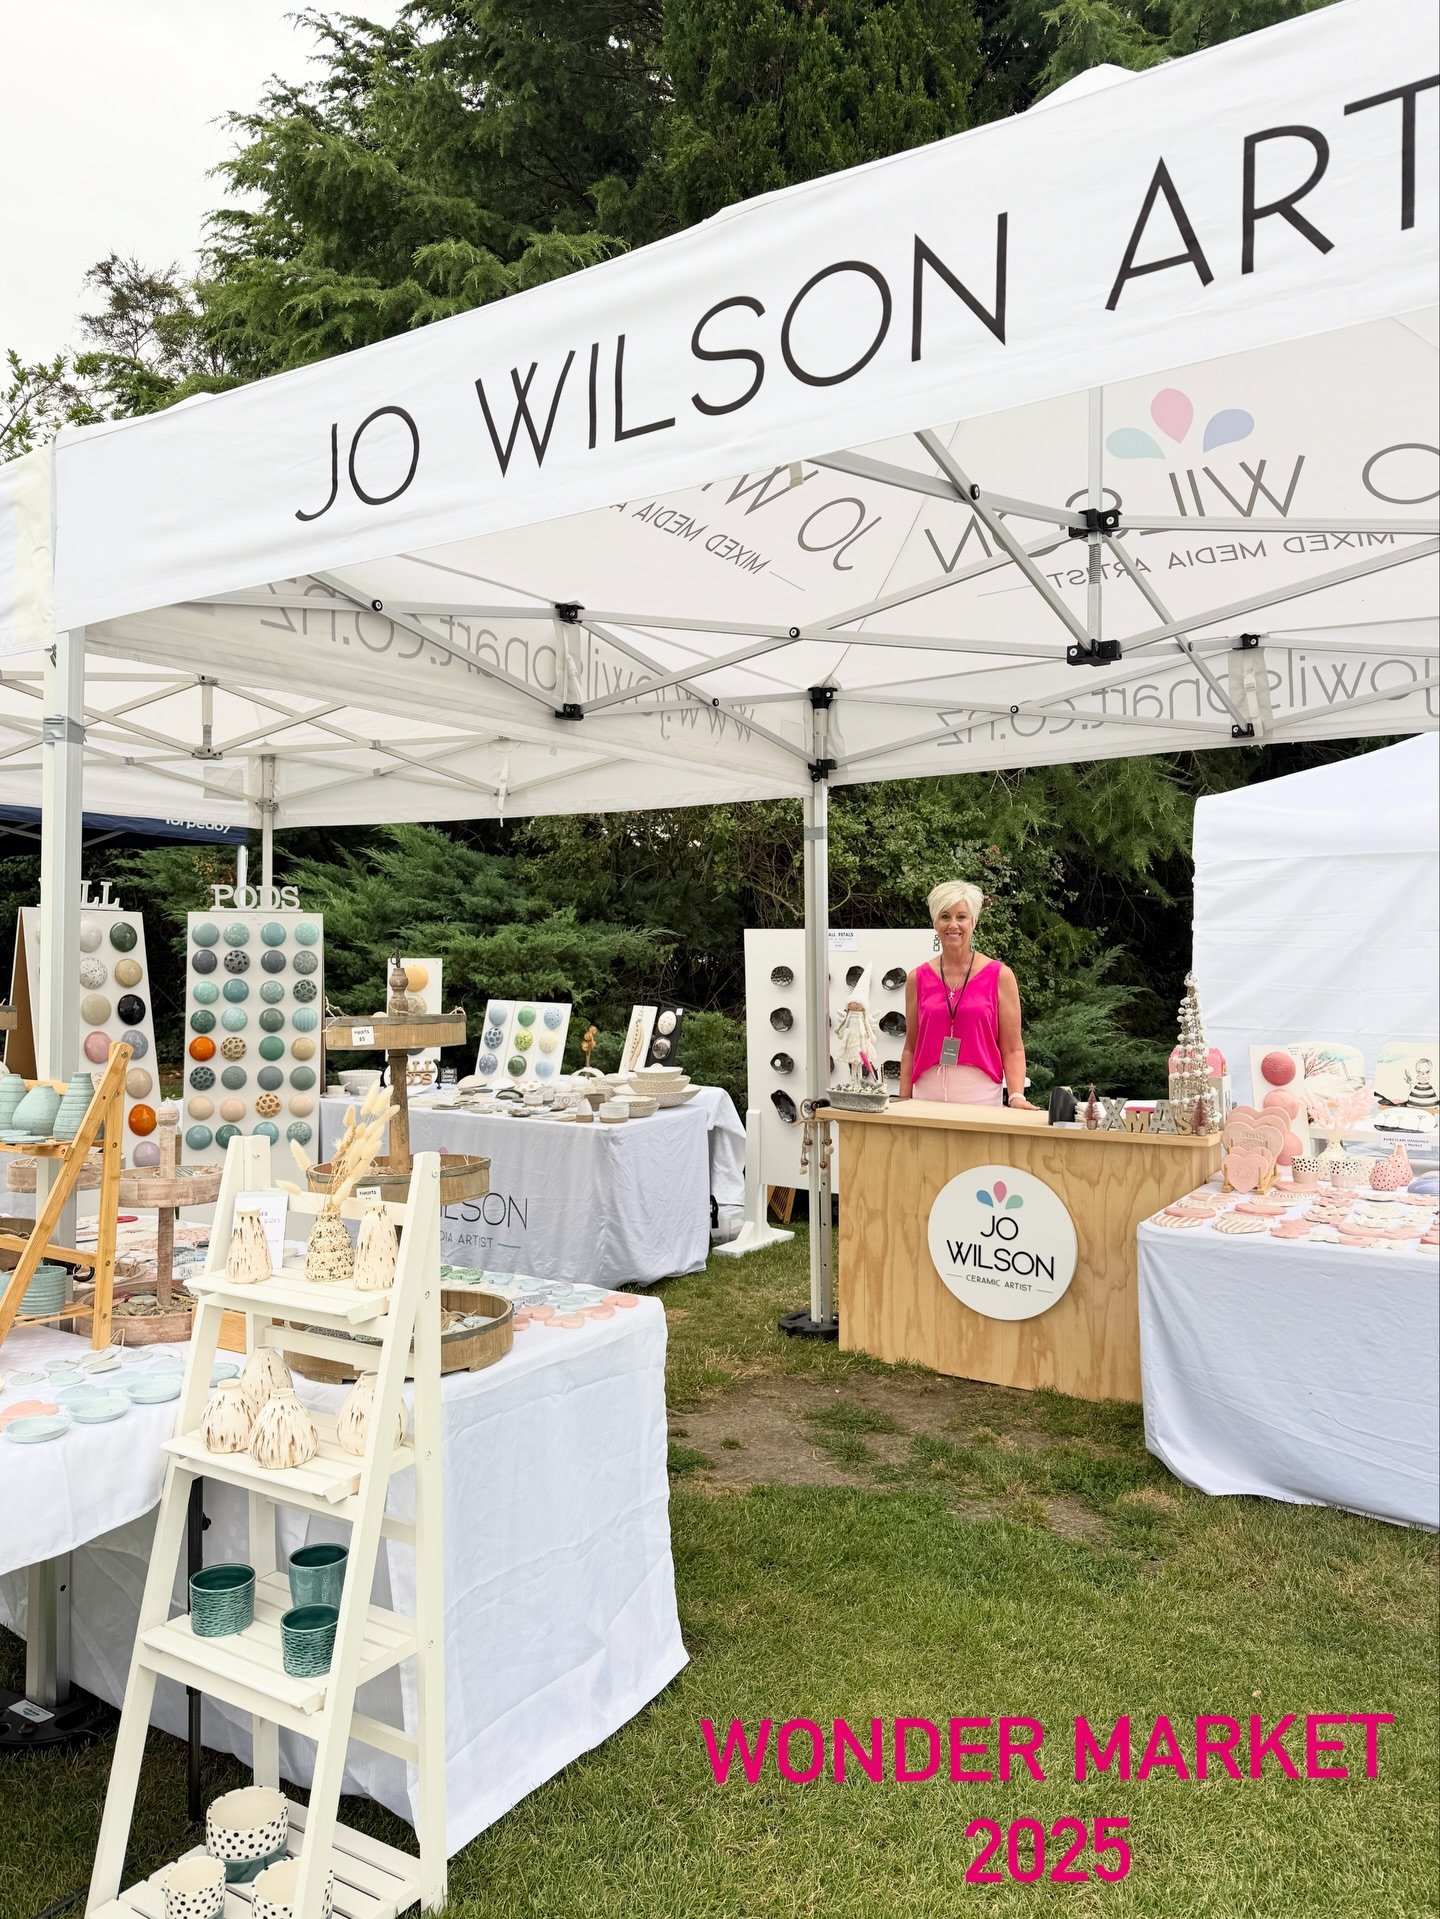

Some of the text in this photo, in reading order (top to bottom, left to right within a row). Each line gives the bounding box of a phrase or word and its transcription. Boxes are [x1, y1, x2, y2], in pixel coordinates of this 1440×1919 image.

[296, 406, 419, 521] JO
[474, 212, 1008, 478] WILSON
[210, 884, 301, 910] PODS
[1099, 1097, 1193, 1135] XMAS
[440, 1231, 494, 1249] DIA ARTIST
[980, 1215, 1019, 1241] JO
[946, 1239, 1055, 1282] WILSON
[966, 1274, 1033, 1292] CERAMIC ARTIST
